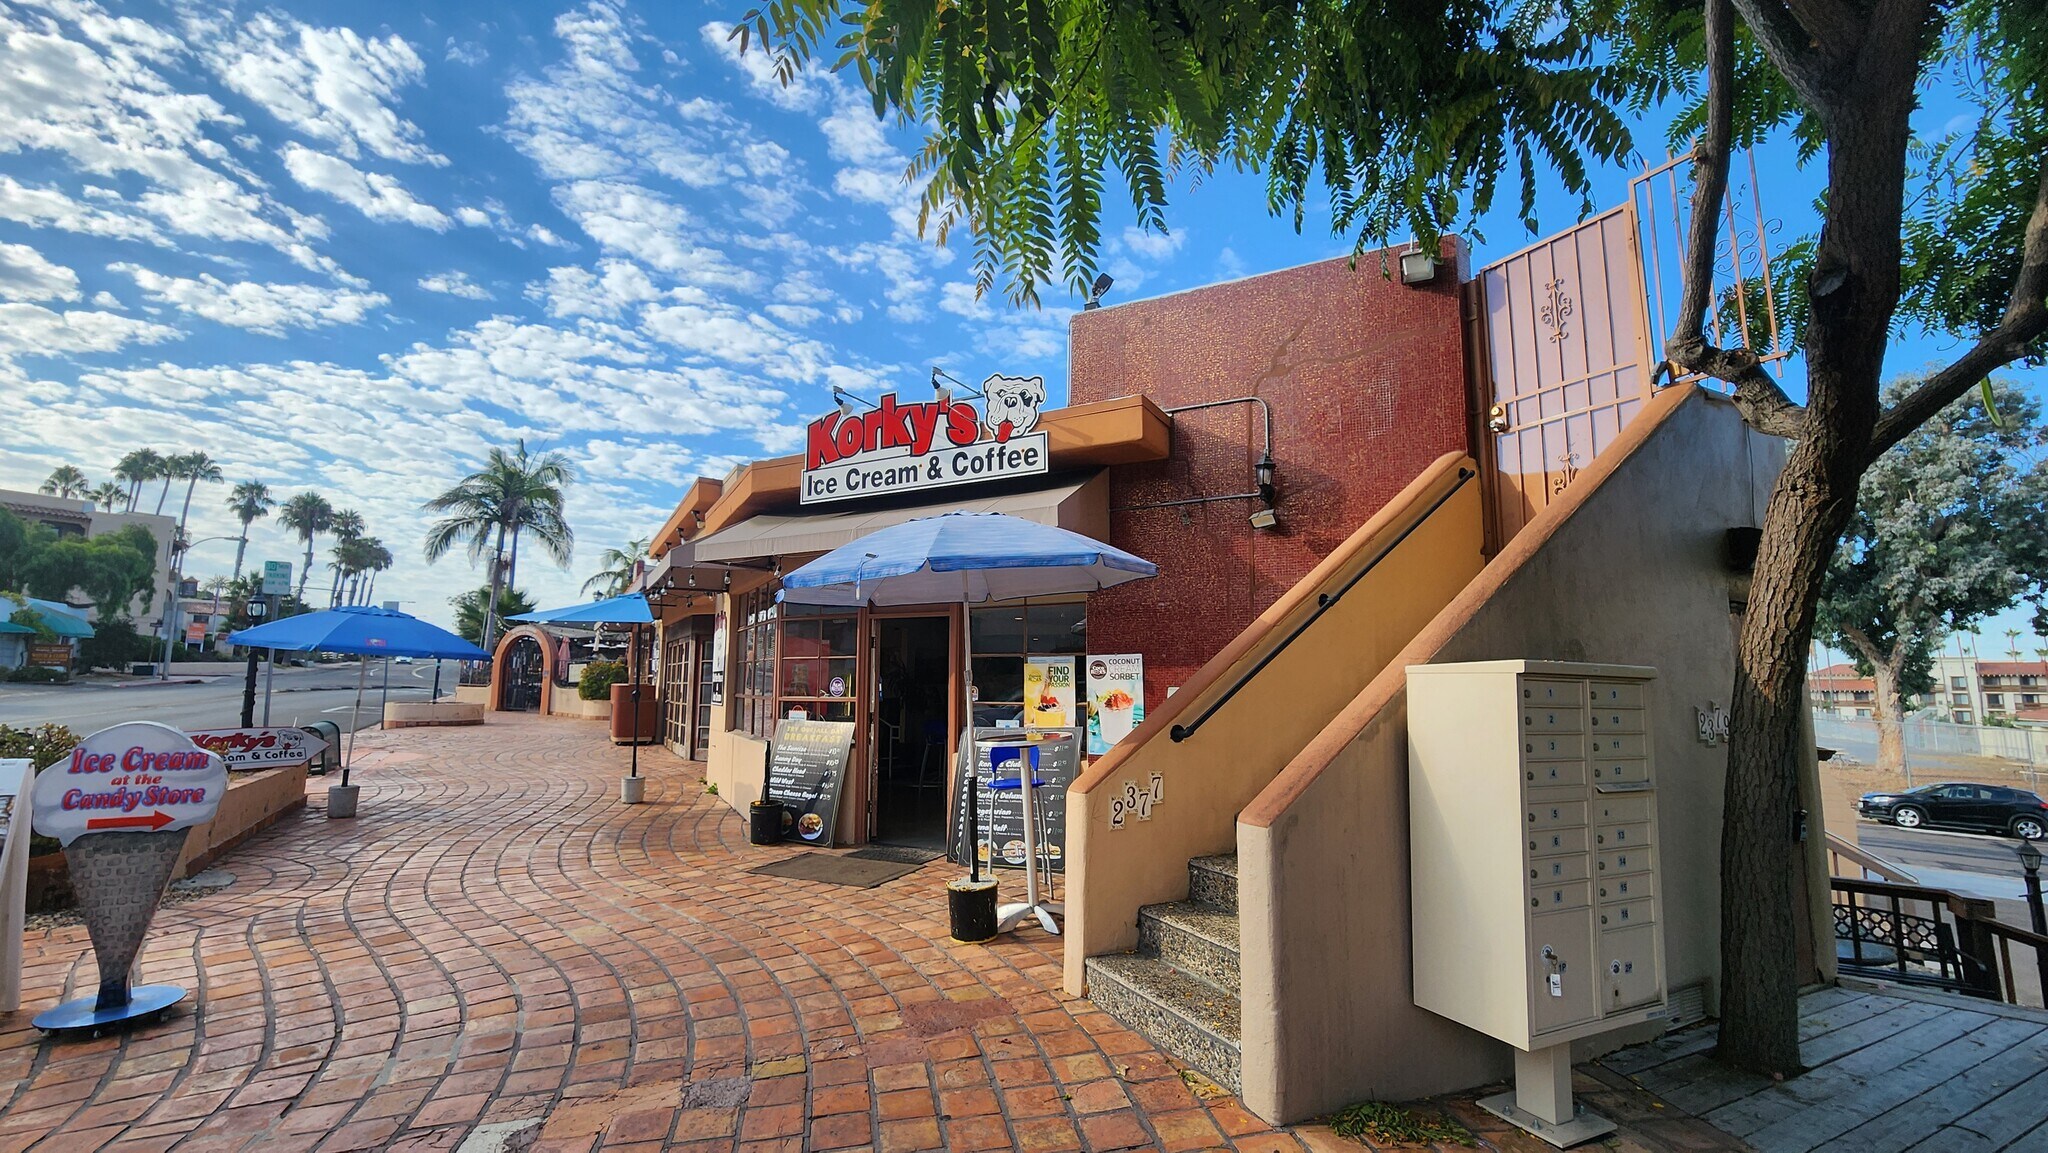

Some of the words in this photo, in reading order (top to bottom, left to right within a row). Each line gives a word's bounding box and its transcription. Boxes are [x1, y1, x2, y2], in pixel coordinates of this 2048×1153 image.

[806, 392, 979, 471] Korky's
[807, 475, 837, 497] Ice
[846, 464, 918, 491] Cream
[927, 455, 943, 480] &
[952, 445, 1039, 476] Coffee
[1048, 666, 1070, 675] FIND
[1109, 665, 1140, 673] CREAM
[1048, 674, 1070, 682] YOUR
[1109, 672, 1140, 680] SORBET
[1700, 707, 1730, 741] 2379
[190, 731, 277, 752] Korky's
[783, 733, 843, 744] BREAKFAST
[68, 747, 116, 774] Ice
[121, 746, 210, 773] Cream
[222, 754, 246, 762] eam
[264, 750, 303, 760] Coffee
[111, 775, 129, 786] at
[135, 774, 162, 785] the
[61, 786, 142, 812] Candy
[143, 785, 206, 806] Store
[1112, 776, 1162, 825] 2377
[1618, 831, 1625, 839] 13
[1620, 883, 1627, 892] 15
[1622, 910, 1628, 918] 16
